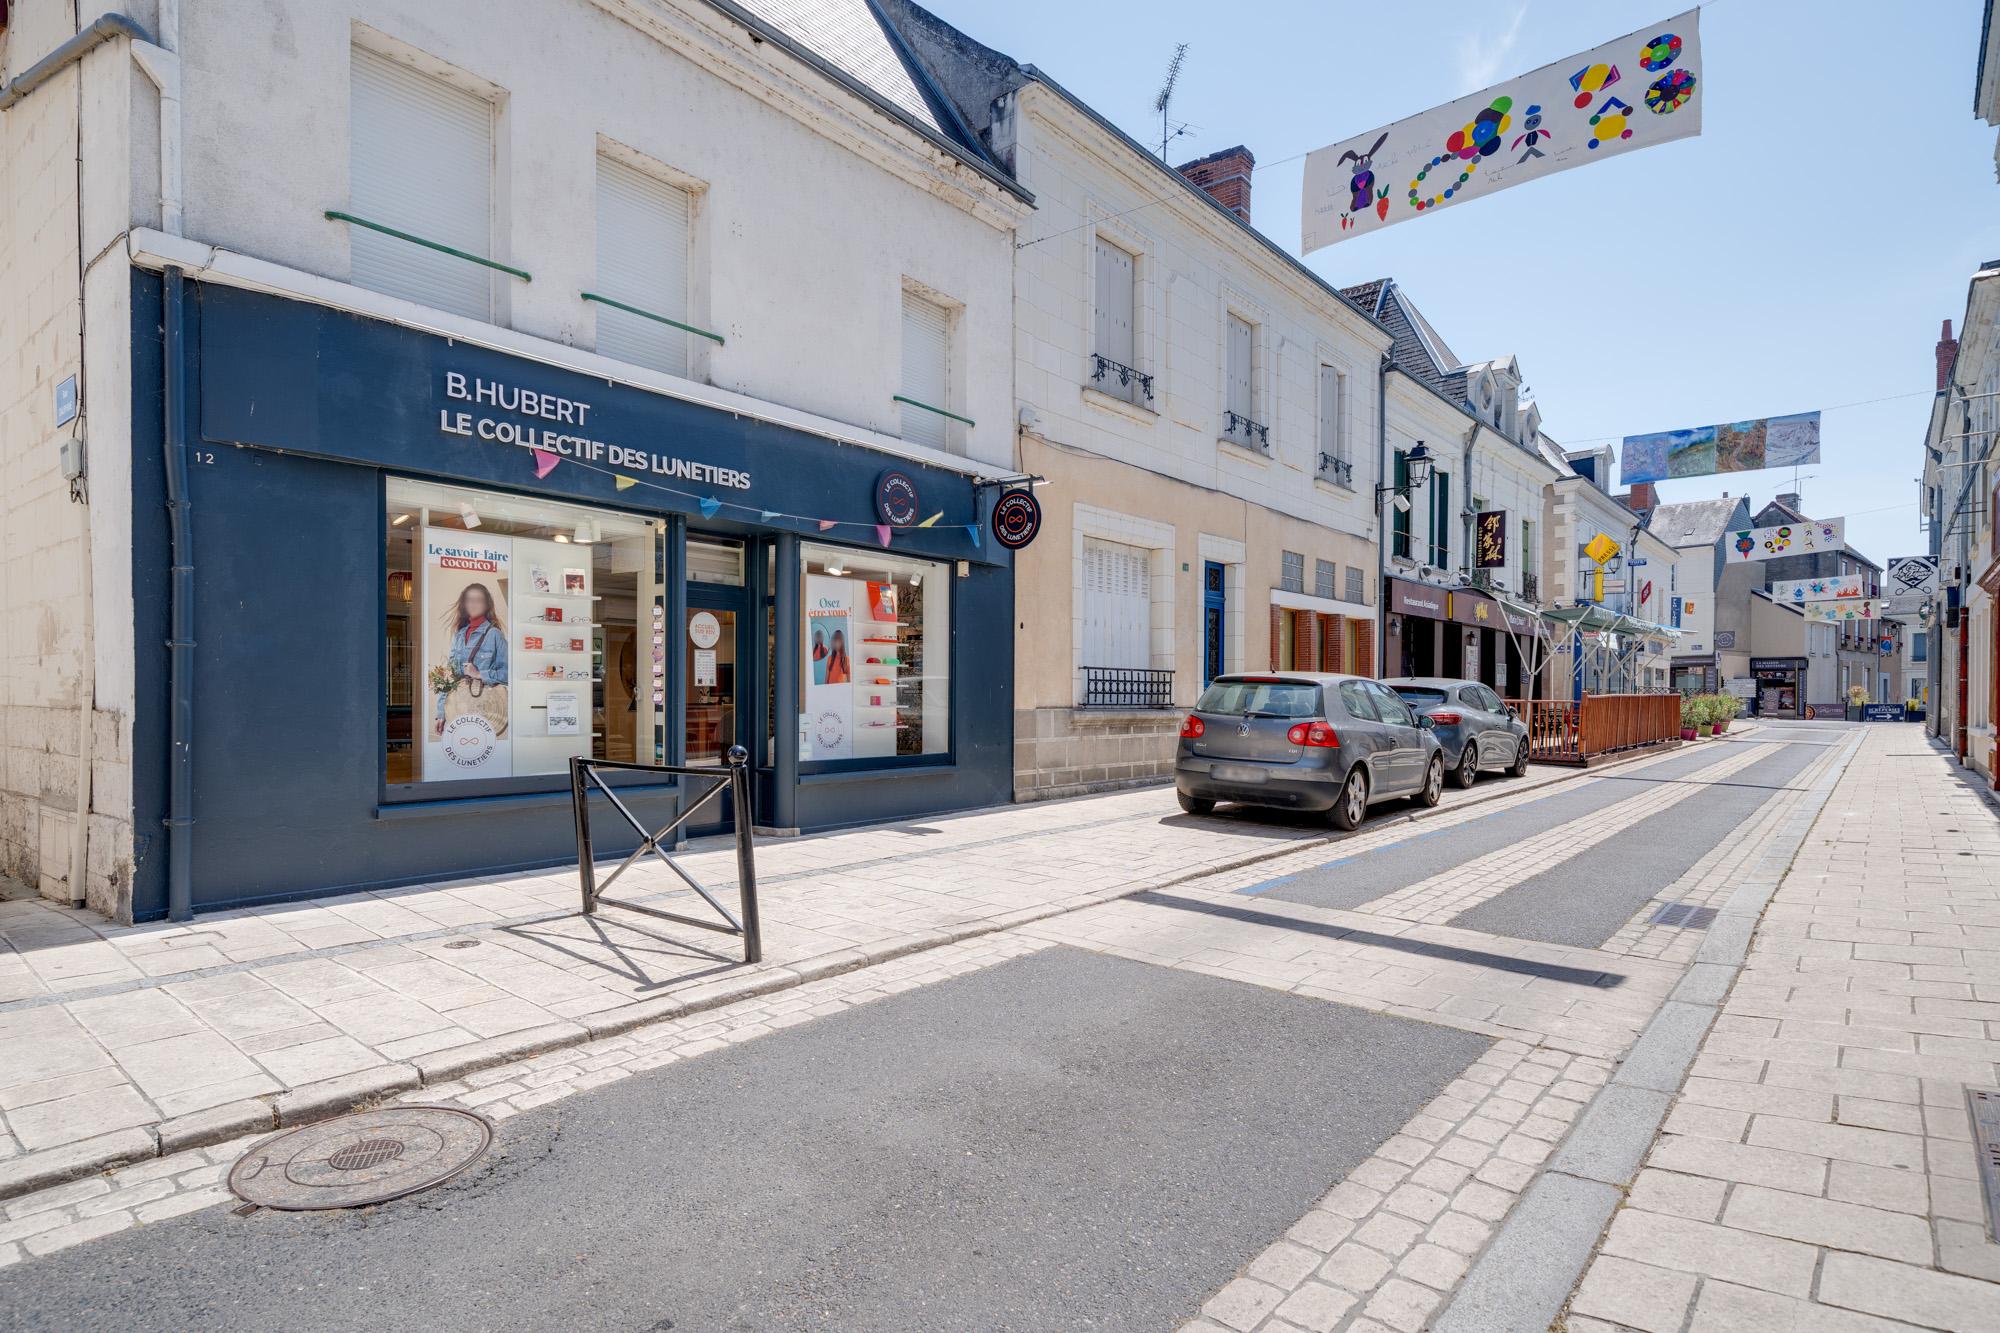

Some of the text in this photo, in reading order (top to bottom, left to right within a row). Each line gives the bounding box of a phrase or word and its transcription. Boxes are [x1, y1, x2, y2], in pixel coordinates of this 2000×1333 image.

[446, 371, 590, 426] B.HUBERT
[440, 409, 751, 490] LE COLLECTIF DES LUNETIERS
[884, 477, 914, 499] LE COLLECTIF
[883, 502, 915, 525] DES LUNETIERS
[999, 498, 1033, 515] LE COLLECTIF
[999, 522, 1033, 541] DES LUNETIERS
[428, 543, 509, 561] Le savoir-faire
[1598, 545, 1617, 563] PRESSE
[442, 558, 490, 570] cocorico
[819, 598, 841, 608] Osez
[447, 716, 492, 734] LE COLLECTIF
[445, 745, 493, 767] DES LUNETIERS
